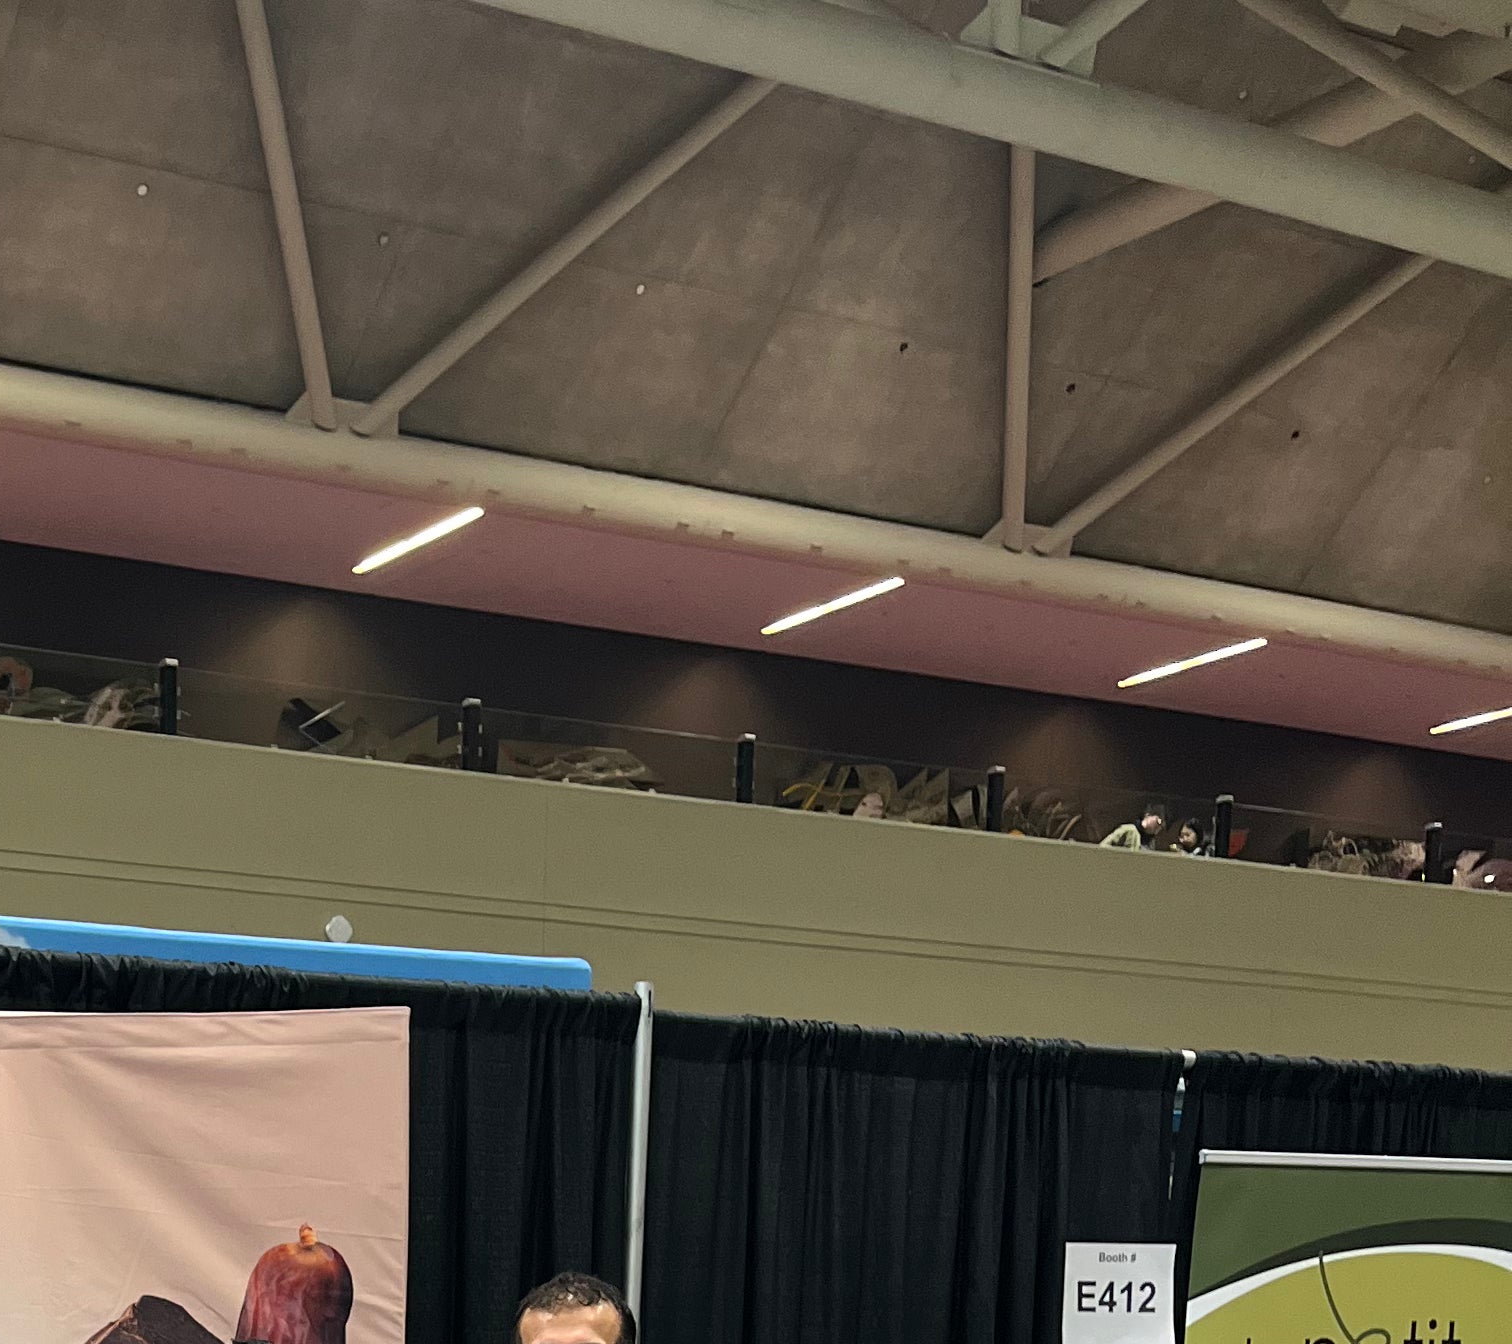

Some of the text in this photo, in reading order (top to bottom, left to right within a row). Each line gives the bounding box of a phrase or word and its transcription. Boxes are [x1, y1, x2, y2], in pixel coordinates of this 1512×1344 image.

[1099, 1252, 1137, 1263] Booth #
[1077, 1281, 1156, 1313] E412
